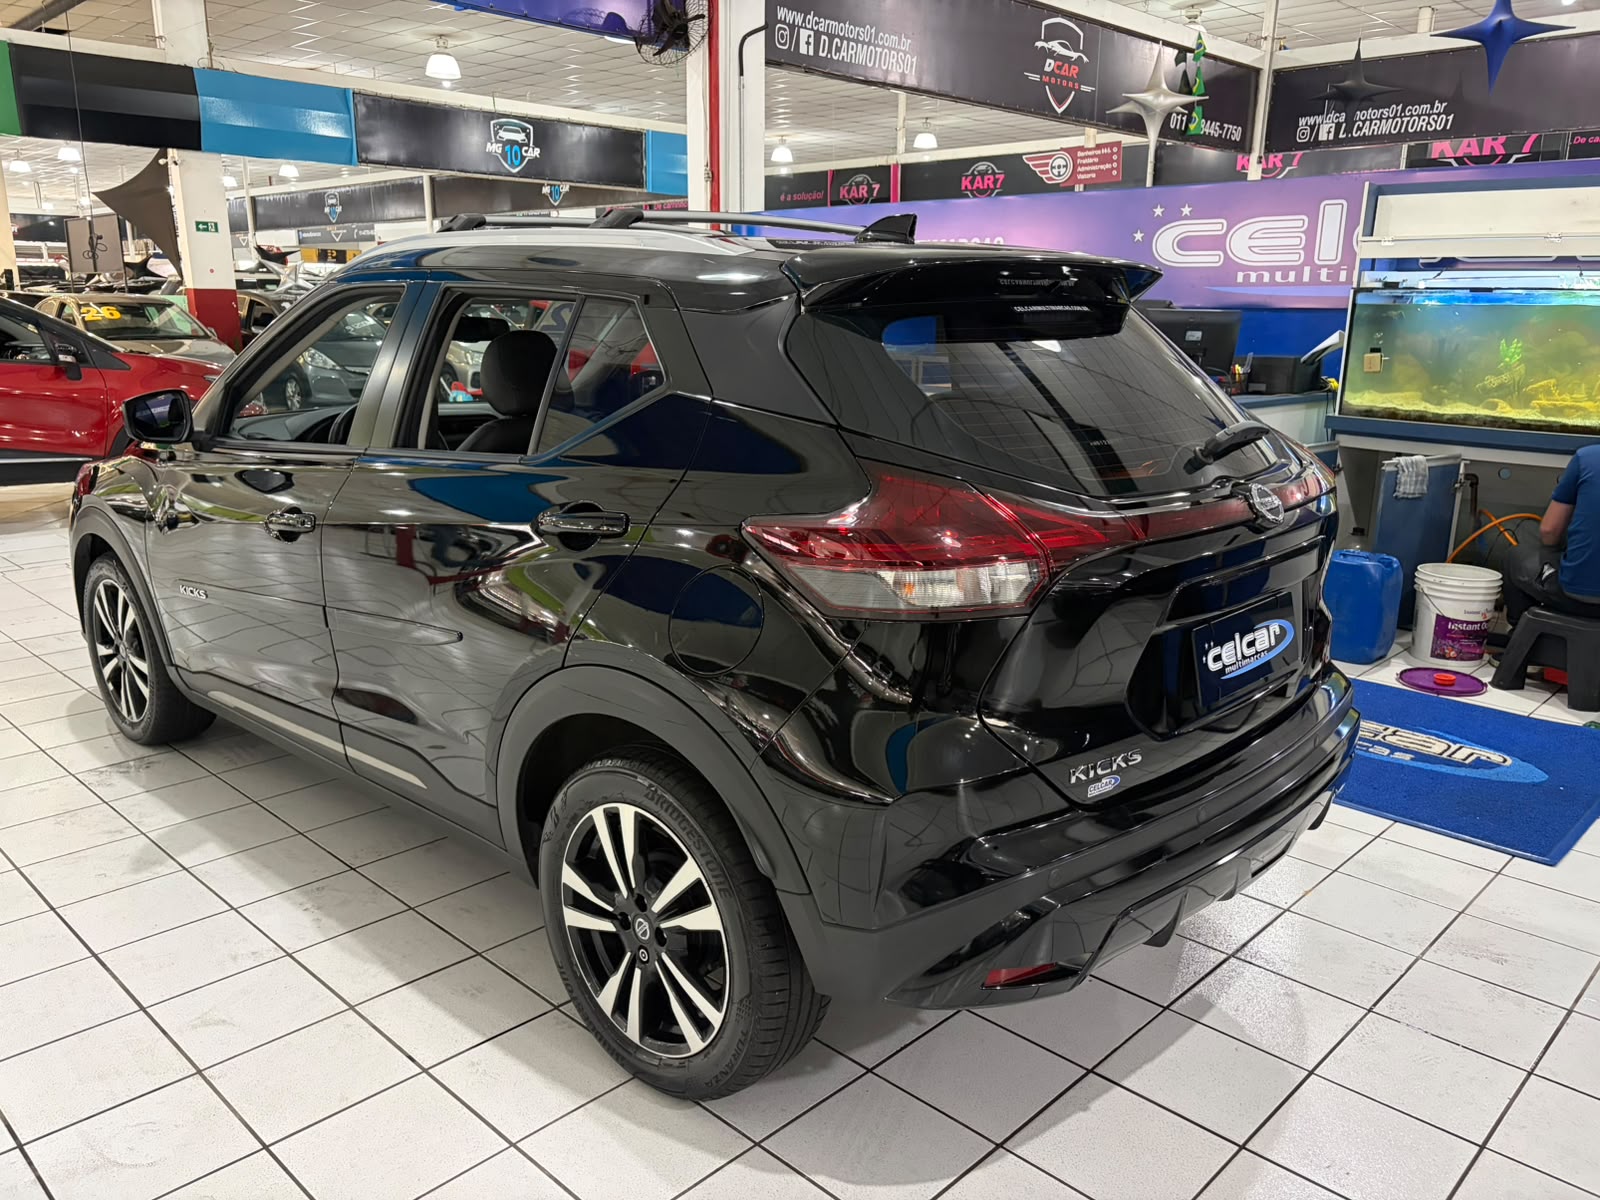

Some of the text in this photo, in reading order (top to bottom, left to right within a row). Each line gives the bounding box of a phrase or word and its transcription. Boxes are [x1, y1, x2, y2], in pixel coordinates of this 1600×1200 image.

[777, 5, 912, 51] www.dcarmotors01.com.br
[819, 35, 918, 76] D.CARMOTORS01
[1044, 58, 1080, 79] DCAR
[1042, 75, 1079, 90] MOTORS
[1169, 112, 1187, 130] 011
[1431, 136, 1507, 158] KAR
[1573, 136, 1587, 144] De
[486, 142, 540, 166] MG 10 CAR
[840, 183, 881, 199] KAR 7
[1153, 199, 1359, 267] cel
[1236, 266, 1356, 284] multi
[180, 584, 208, 600] KICKS
[1207, 622, 1280, 672] celcar
[1225, 650, 1268, 674] multimarcas
[1069, 748, 1142, 784] KICKS
